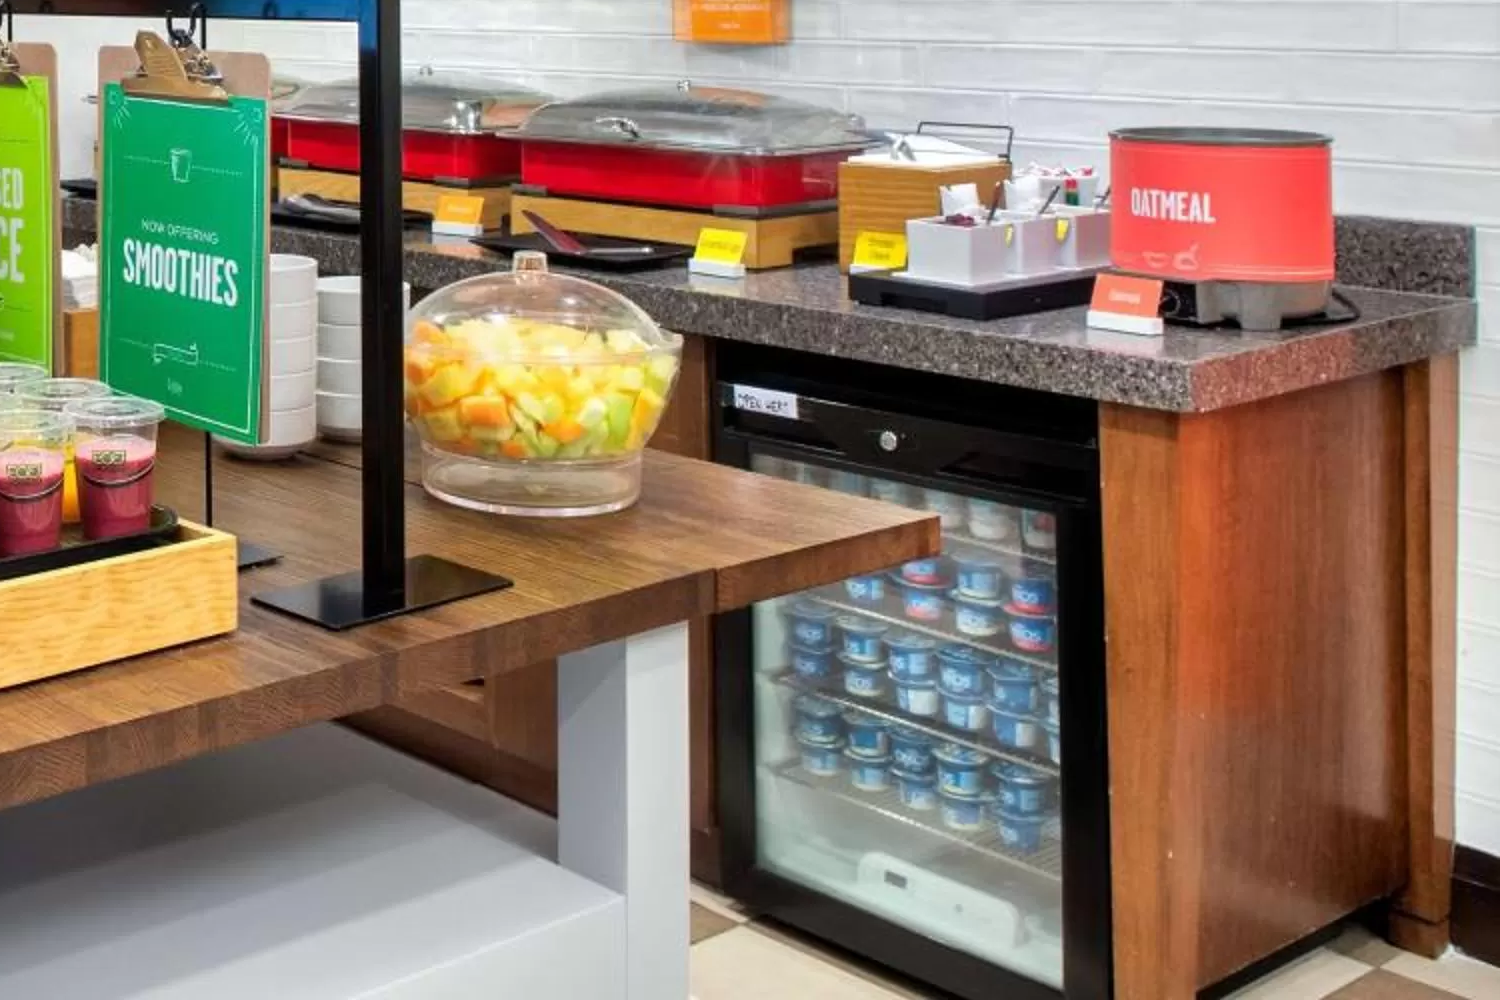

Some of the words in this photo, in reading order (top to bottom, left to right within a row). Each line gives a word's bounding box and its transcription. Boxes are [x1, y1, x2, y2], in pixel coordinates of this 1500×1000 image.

[1131, 186, 1217, 225] OATMEAL
[141, 216, 165, 234] NOW
[167, 222, 219, 246] OFFERING
[123, 236, 239, 308] SMOOTHIES
